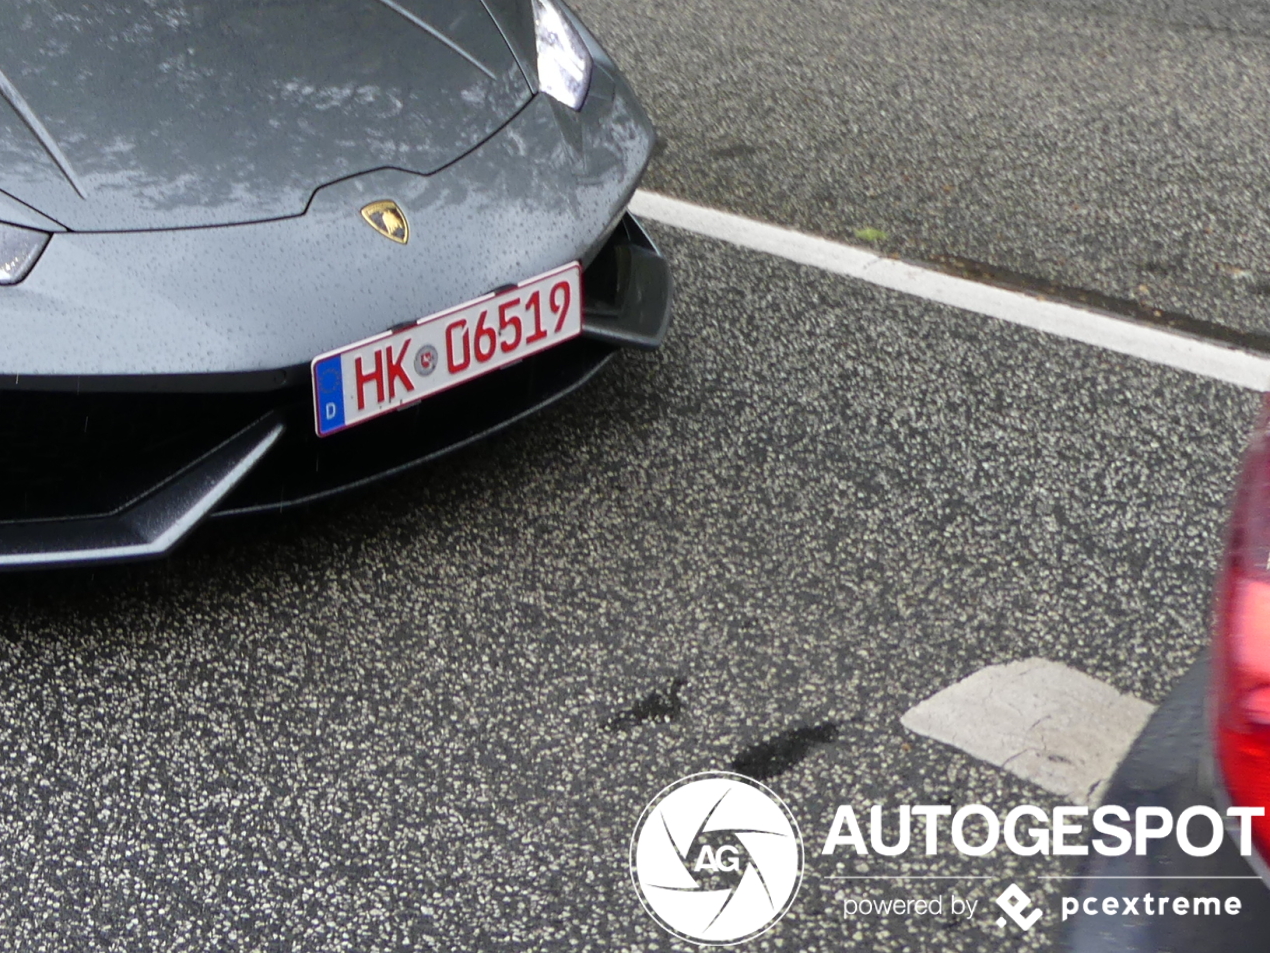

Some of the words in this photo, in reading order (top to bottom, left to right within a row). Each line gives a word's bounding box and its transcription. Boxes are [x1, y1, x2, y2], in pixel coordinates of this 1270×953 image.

[325, 402, 337, 420] D
[354, 338, 415, 410] HK
[444, 280, 572, 375] 06519
